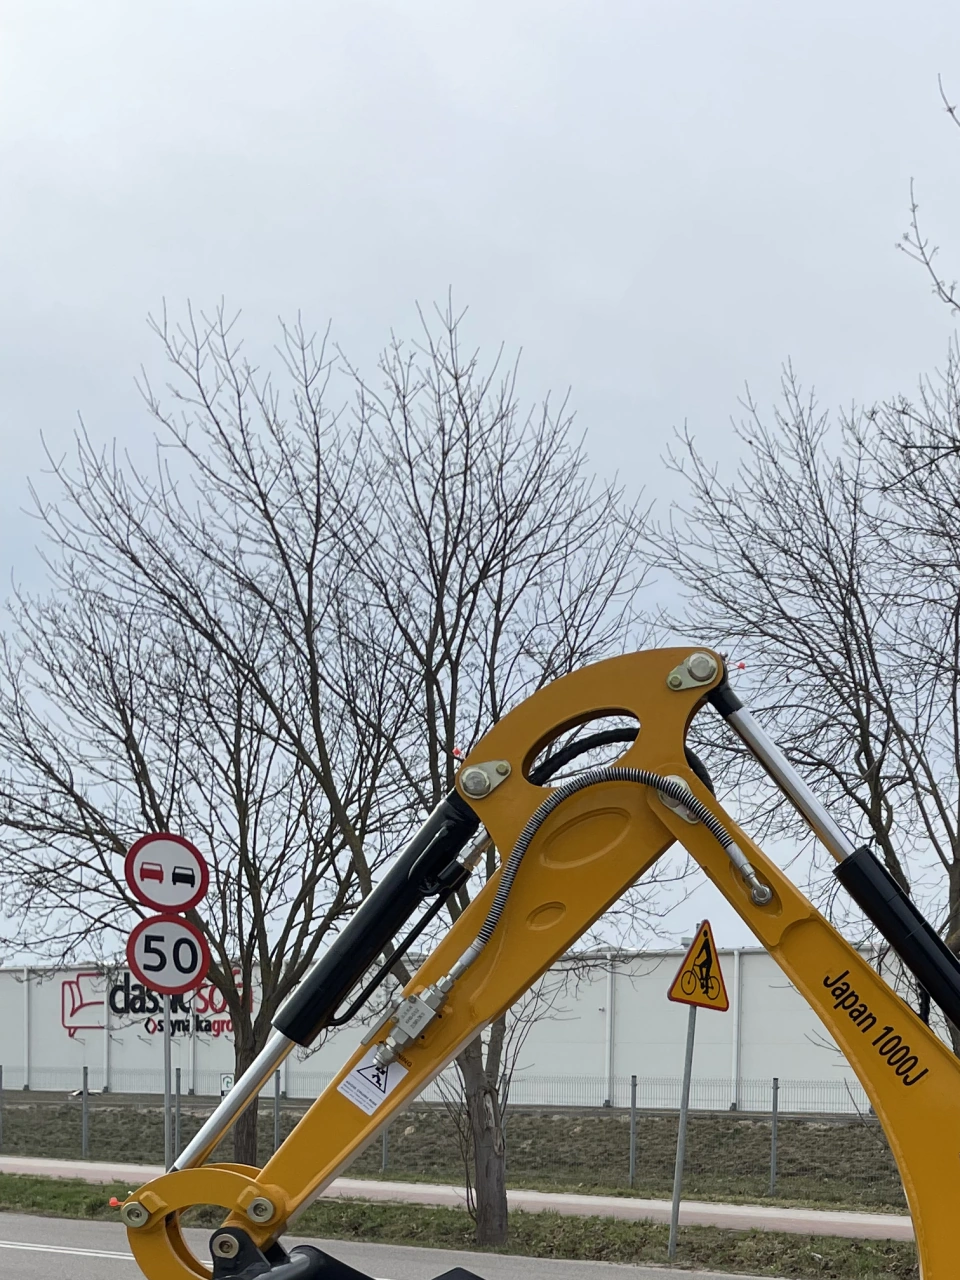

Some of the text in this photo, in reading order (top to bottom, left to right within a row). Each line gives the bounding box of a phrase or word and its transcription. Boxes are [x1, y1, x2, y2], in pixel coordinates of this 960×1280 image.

[143, 935, 198, 974] 50
[823, 970, 929, 1086] Japan 1000J
